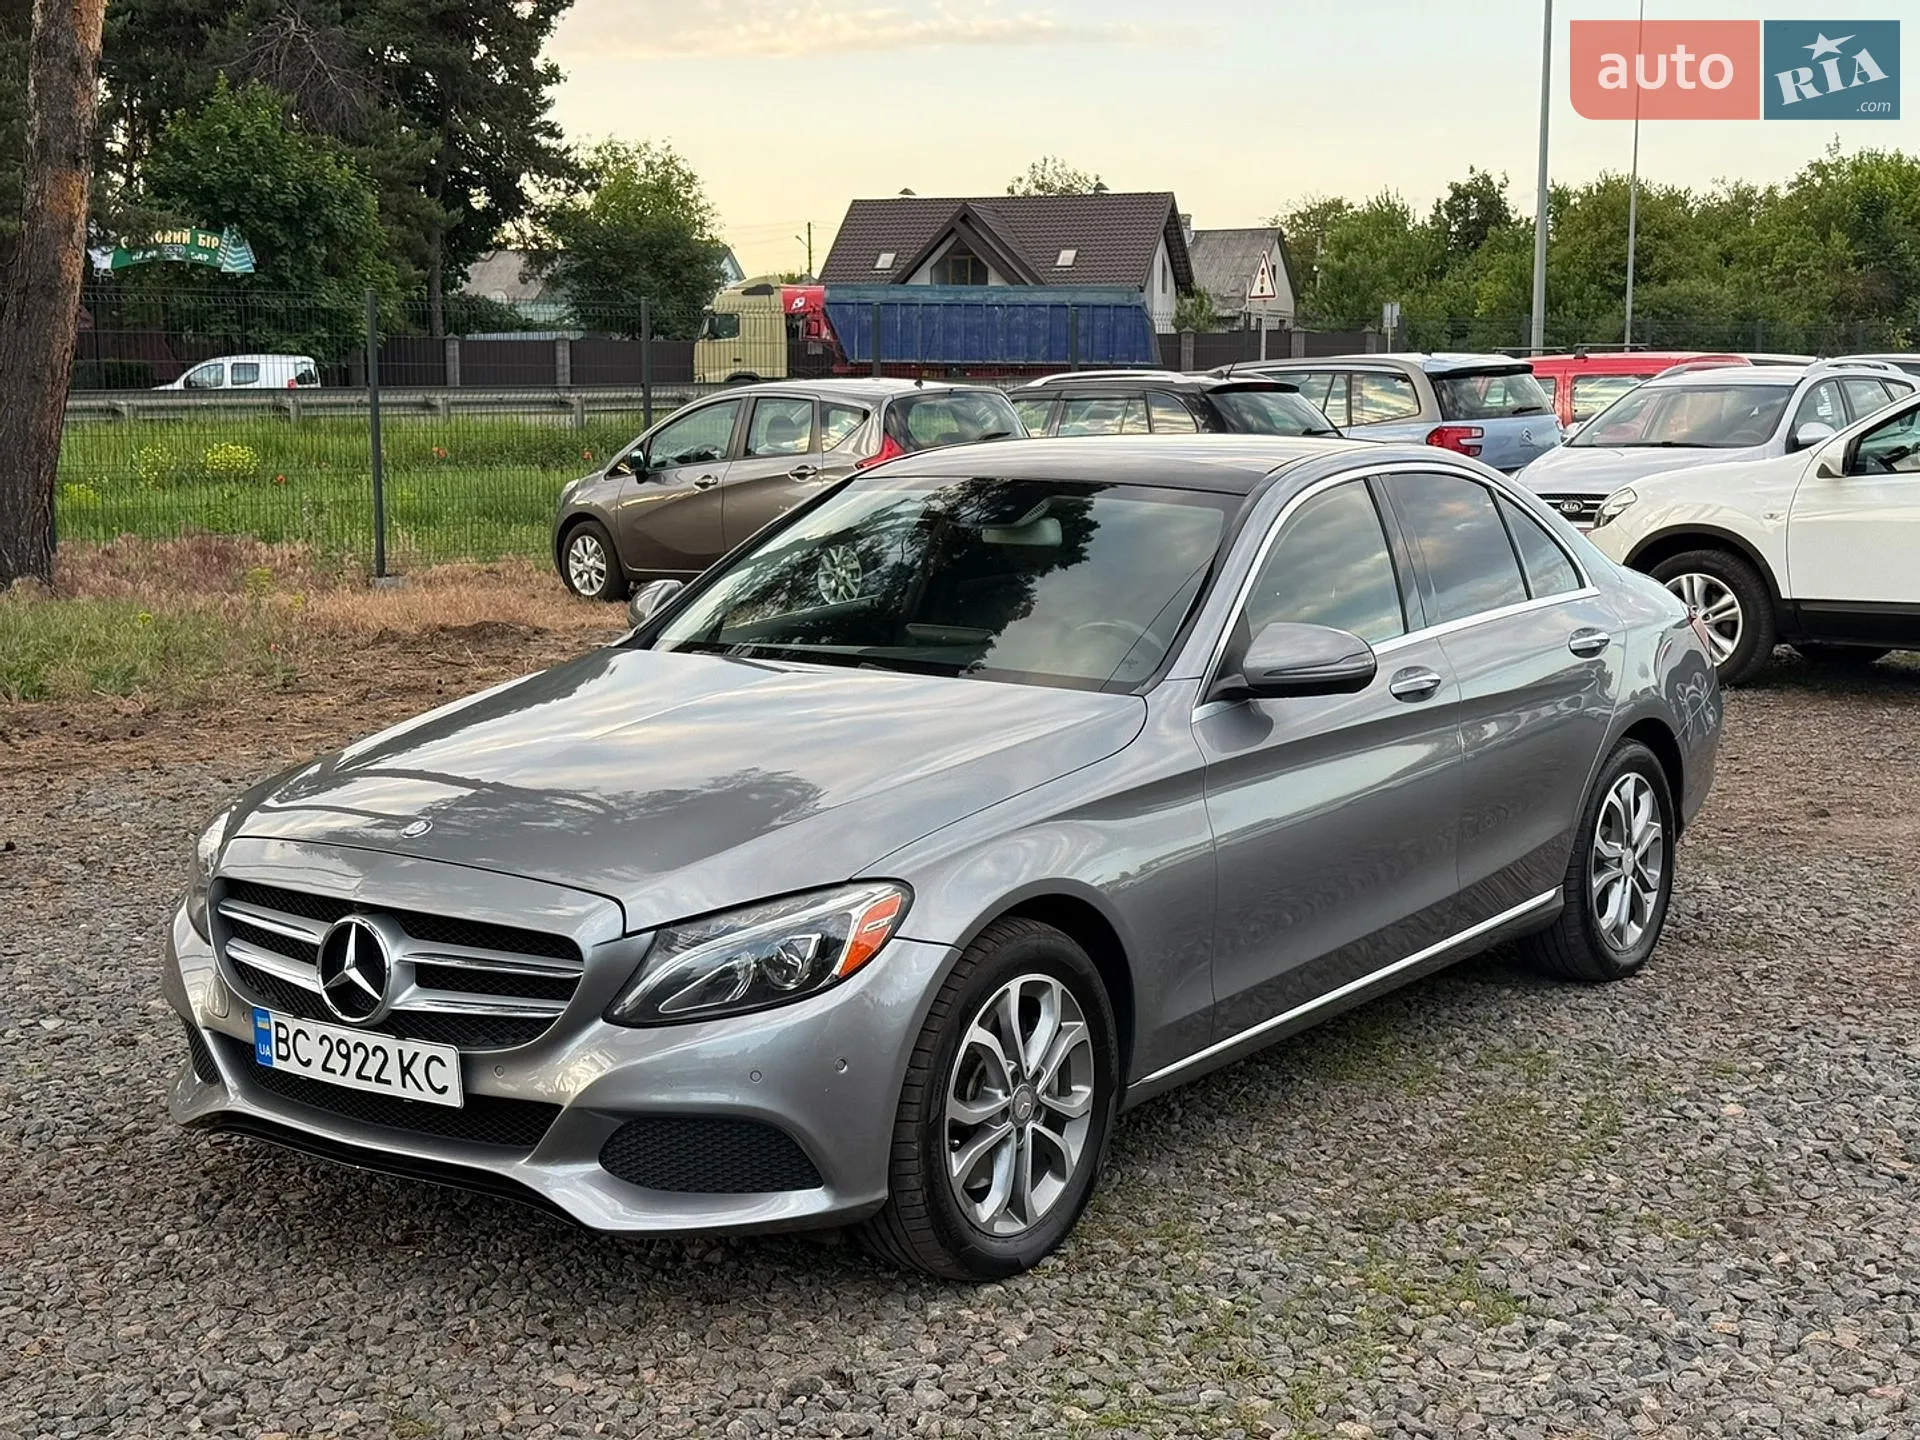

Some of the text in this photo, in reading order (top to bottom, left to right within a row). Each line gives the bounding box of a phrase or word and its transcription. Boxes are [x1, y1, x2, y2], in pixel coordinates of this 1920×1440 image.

[258, 1043, 272, 1058] UA
[274, 1020, 450, 1095] BC 2922 KC
